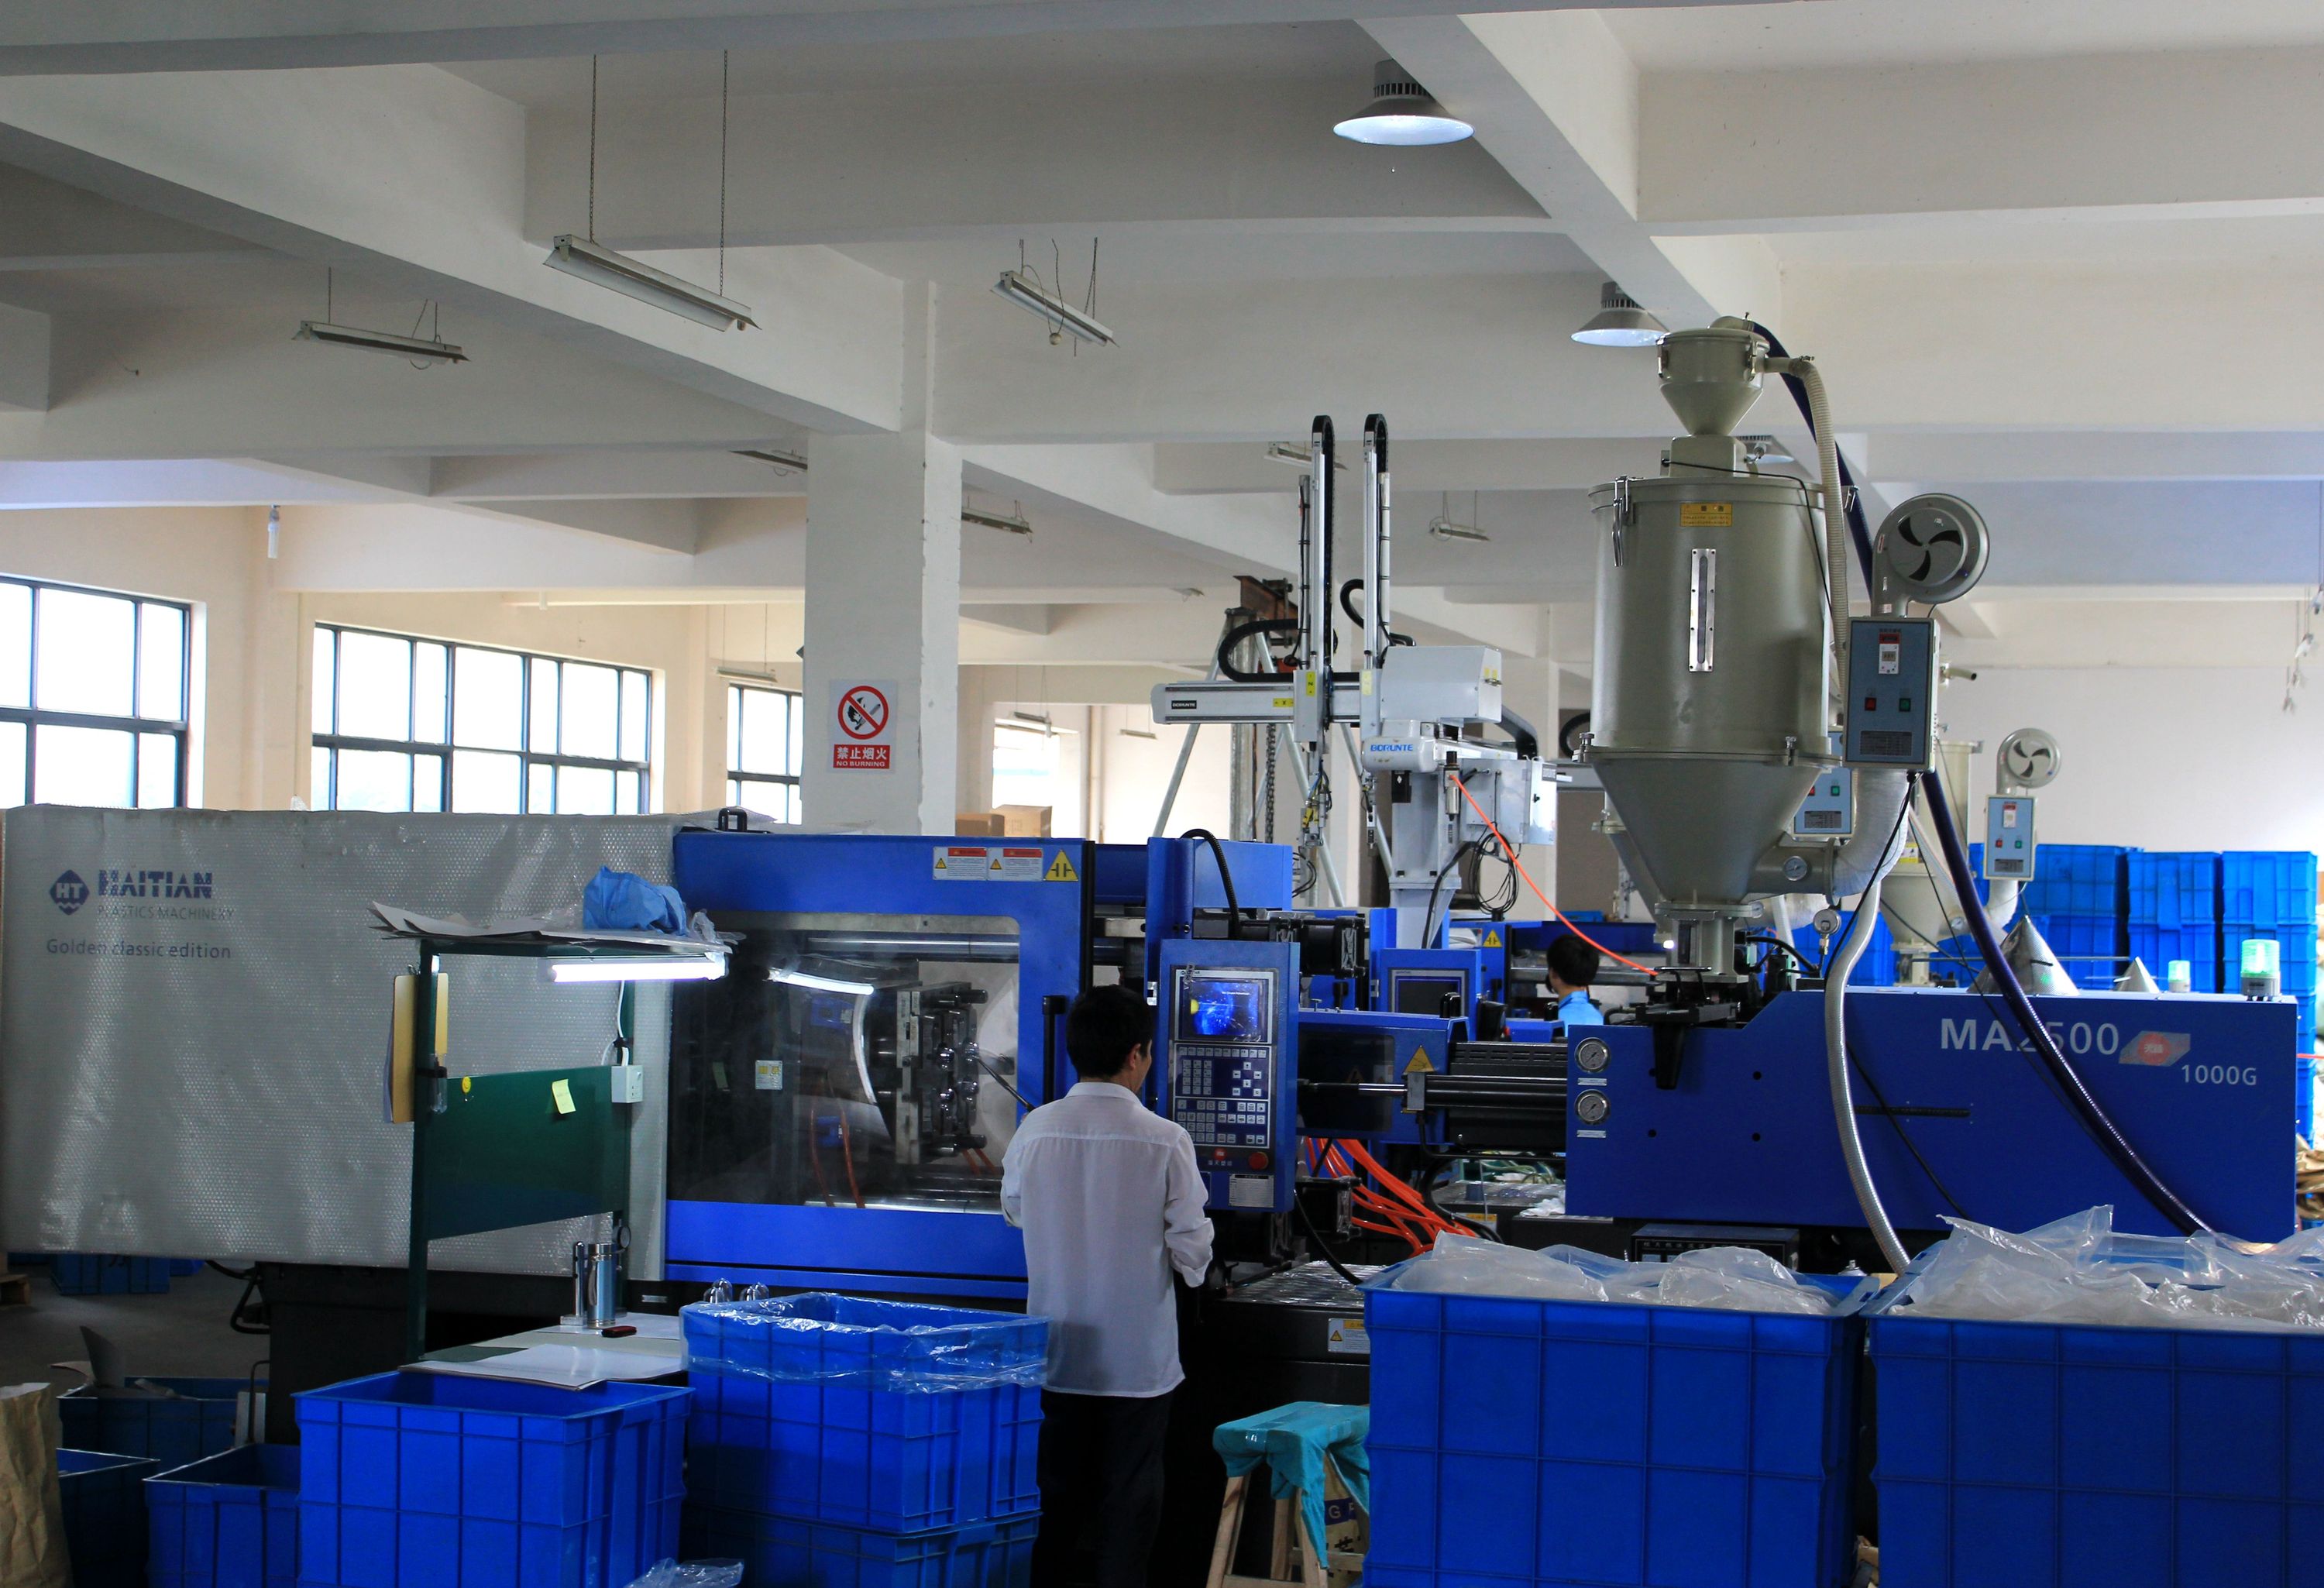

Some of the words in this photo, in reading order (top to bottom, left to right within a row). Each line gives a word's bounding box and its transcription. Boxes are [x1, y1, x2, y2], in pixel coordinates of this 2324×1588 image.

[837, 747, 887, 760] 禁止烟火
[56, 882, 83, 899] HT
[98, 869, 212, 899] HAITIAN
[46, 939, 107, 955] Golden
[114, 940, 163, 957] classic
[169, 942, 231, 959] edition
[2181, 1064, 2257, 1085] 1000G
